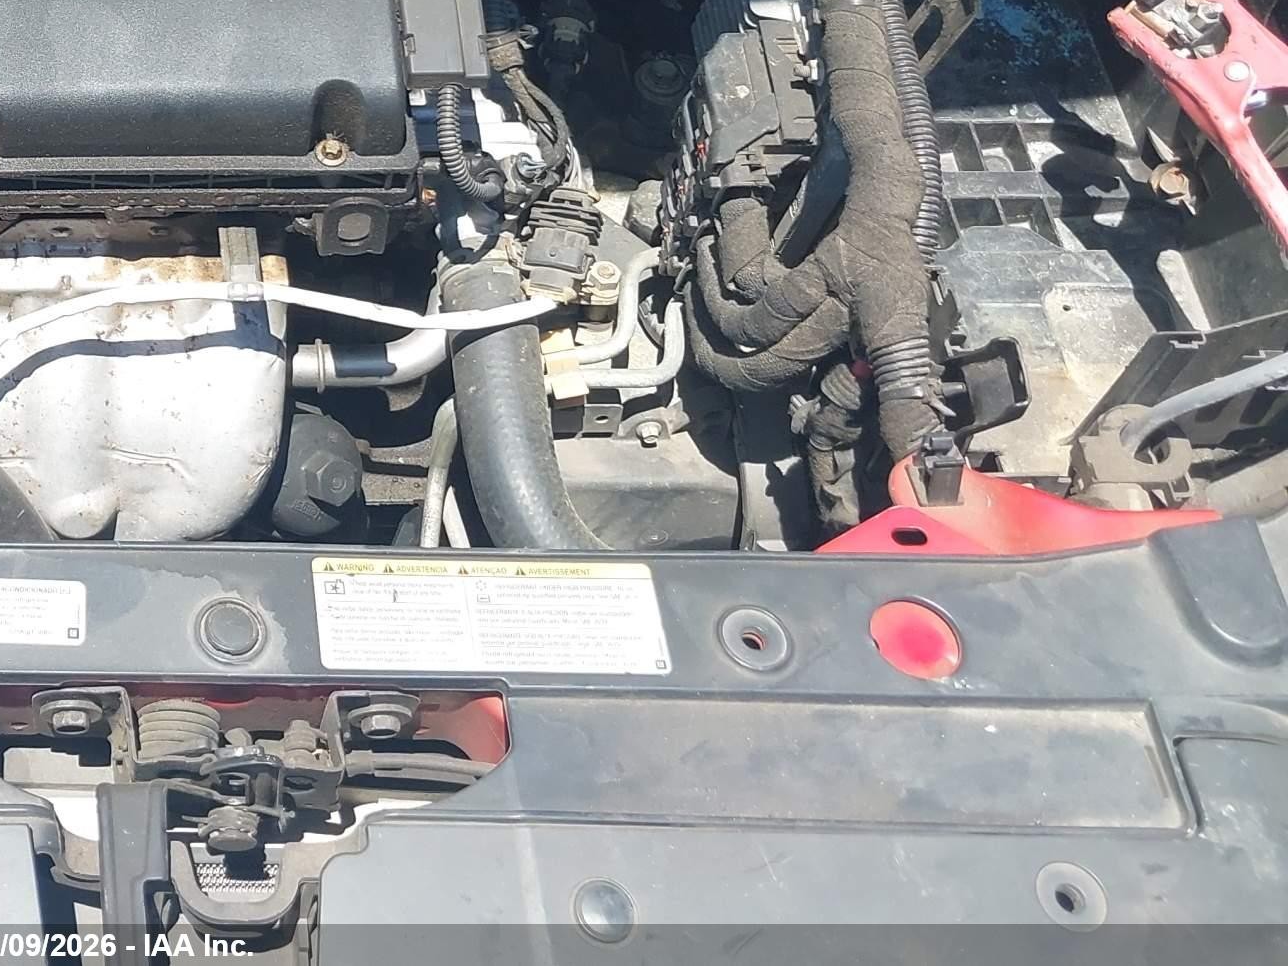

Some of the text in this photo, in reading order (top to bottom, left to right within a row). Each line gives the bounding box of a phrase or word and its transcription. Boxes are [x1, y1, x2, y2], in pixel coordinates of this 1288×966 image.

[336, 563, 375, 572] WARNING
[396, 565, 448, 574] ADVERTENCIA
[528, 567, 591, 577] AVERTISSEMENT
